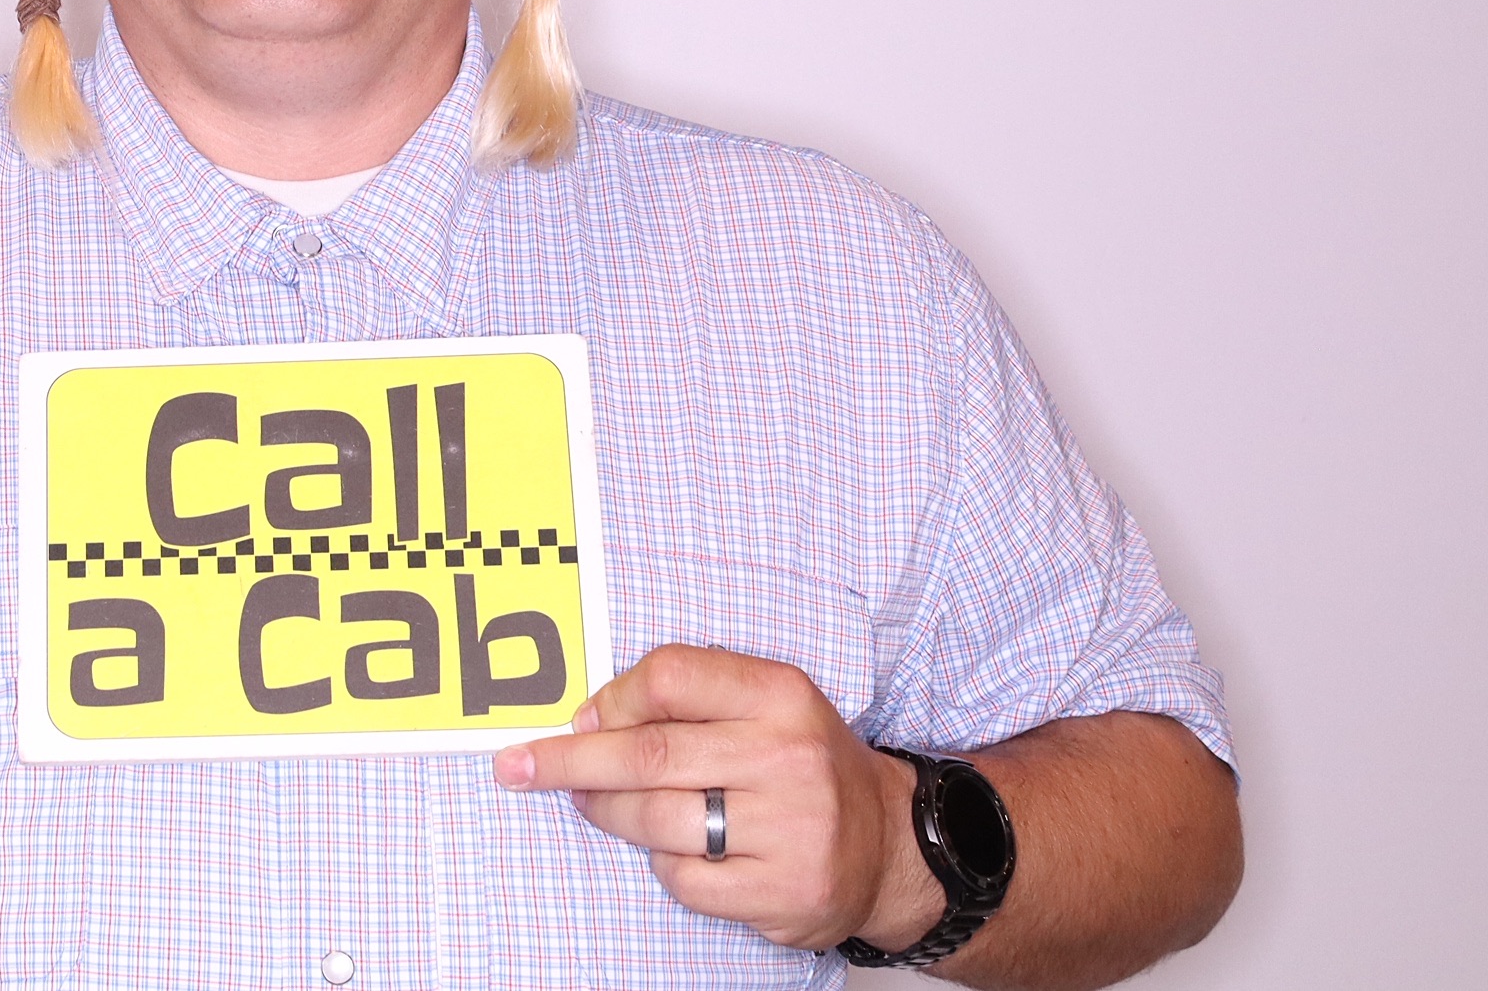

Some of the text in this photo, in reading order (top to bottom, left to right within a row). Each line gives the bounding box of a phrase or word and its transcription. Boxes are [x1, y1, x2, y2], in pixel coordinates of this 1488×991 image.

[145, 382, 468, 547] Call
[67, 573, 568, 717] a Cab
